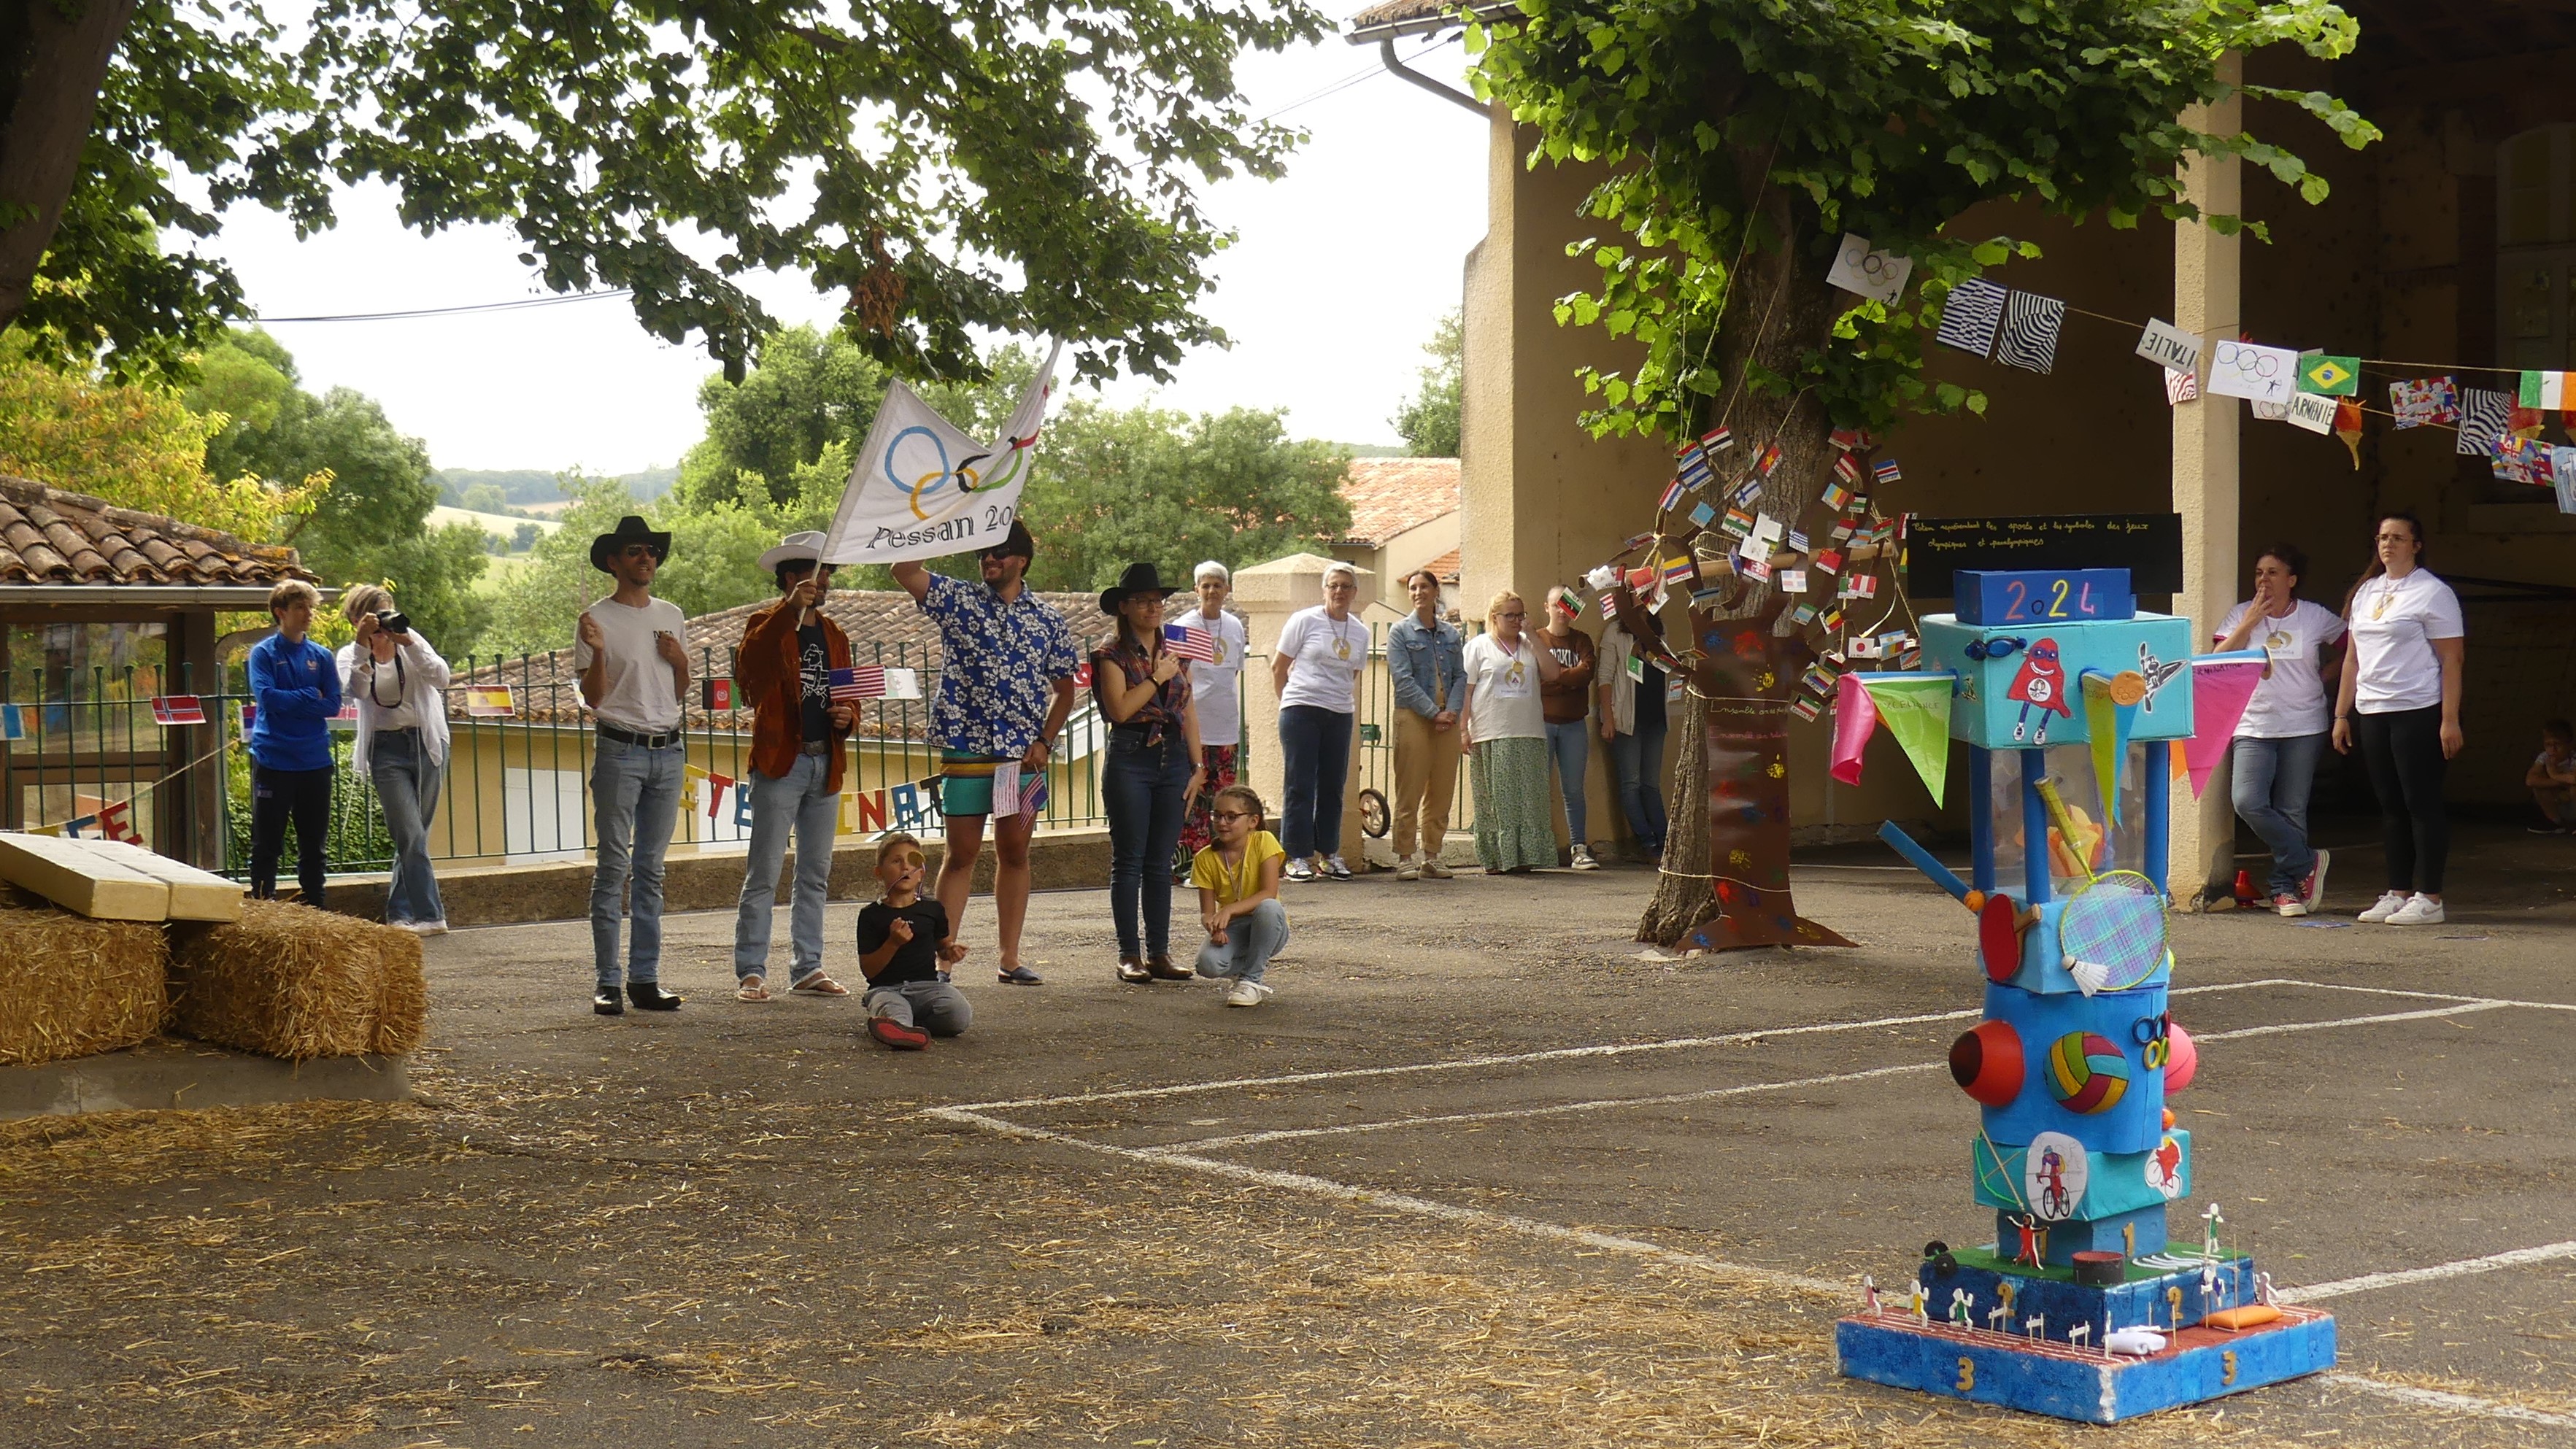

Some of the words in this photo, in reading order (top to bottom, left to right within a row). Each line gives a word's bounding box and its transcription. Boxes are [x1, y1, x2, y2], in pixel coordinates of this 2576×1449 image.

[2145, 332, 2197, 369] ITALIE
[865, 515, 974, 549] Pessan
[985, 495, 1020, 531] 20
[2008, 522, 2033, 533] sports
[2005, 579, 2095, 621] 2024
[2123, 1221, 2135, 1258] 1
[1956, 1356, 1975, 1391] 3
[2221, 1350, 2237, 1386] 3
